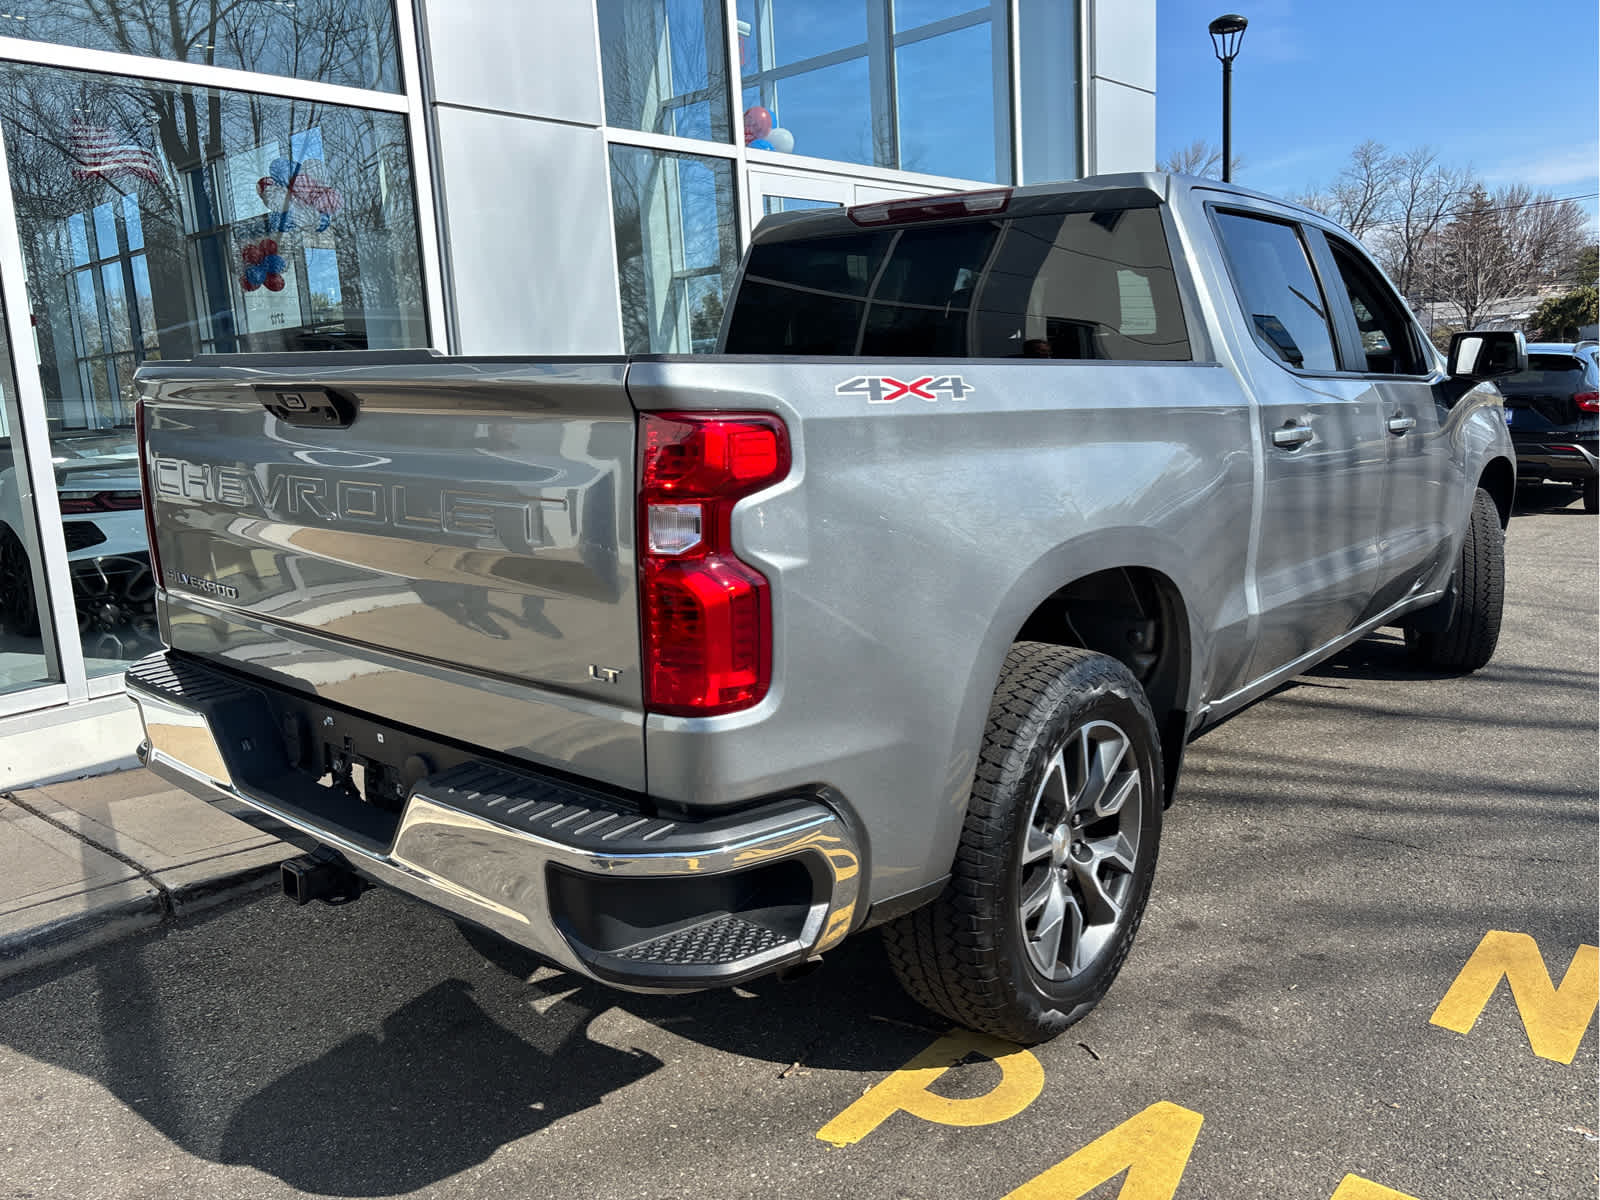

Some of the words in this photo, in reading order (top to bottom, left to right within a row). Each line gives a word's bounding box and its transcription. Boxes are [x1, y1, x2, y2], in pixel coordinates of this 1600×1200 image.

[153, 457, 568, 544] CHEVROLET
[167, 570, 239, 599] SILVERADO
[588, 664, 623, 683] LT
[816, 1029, 1418, 1200] PA
